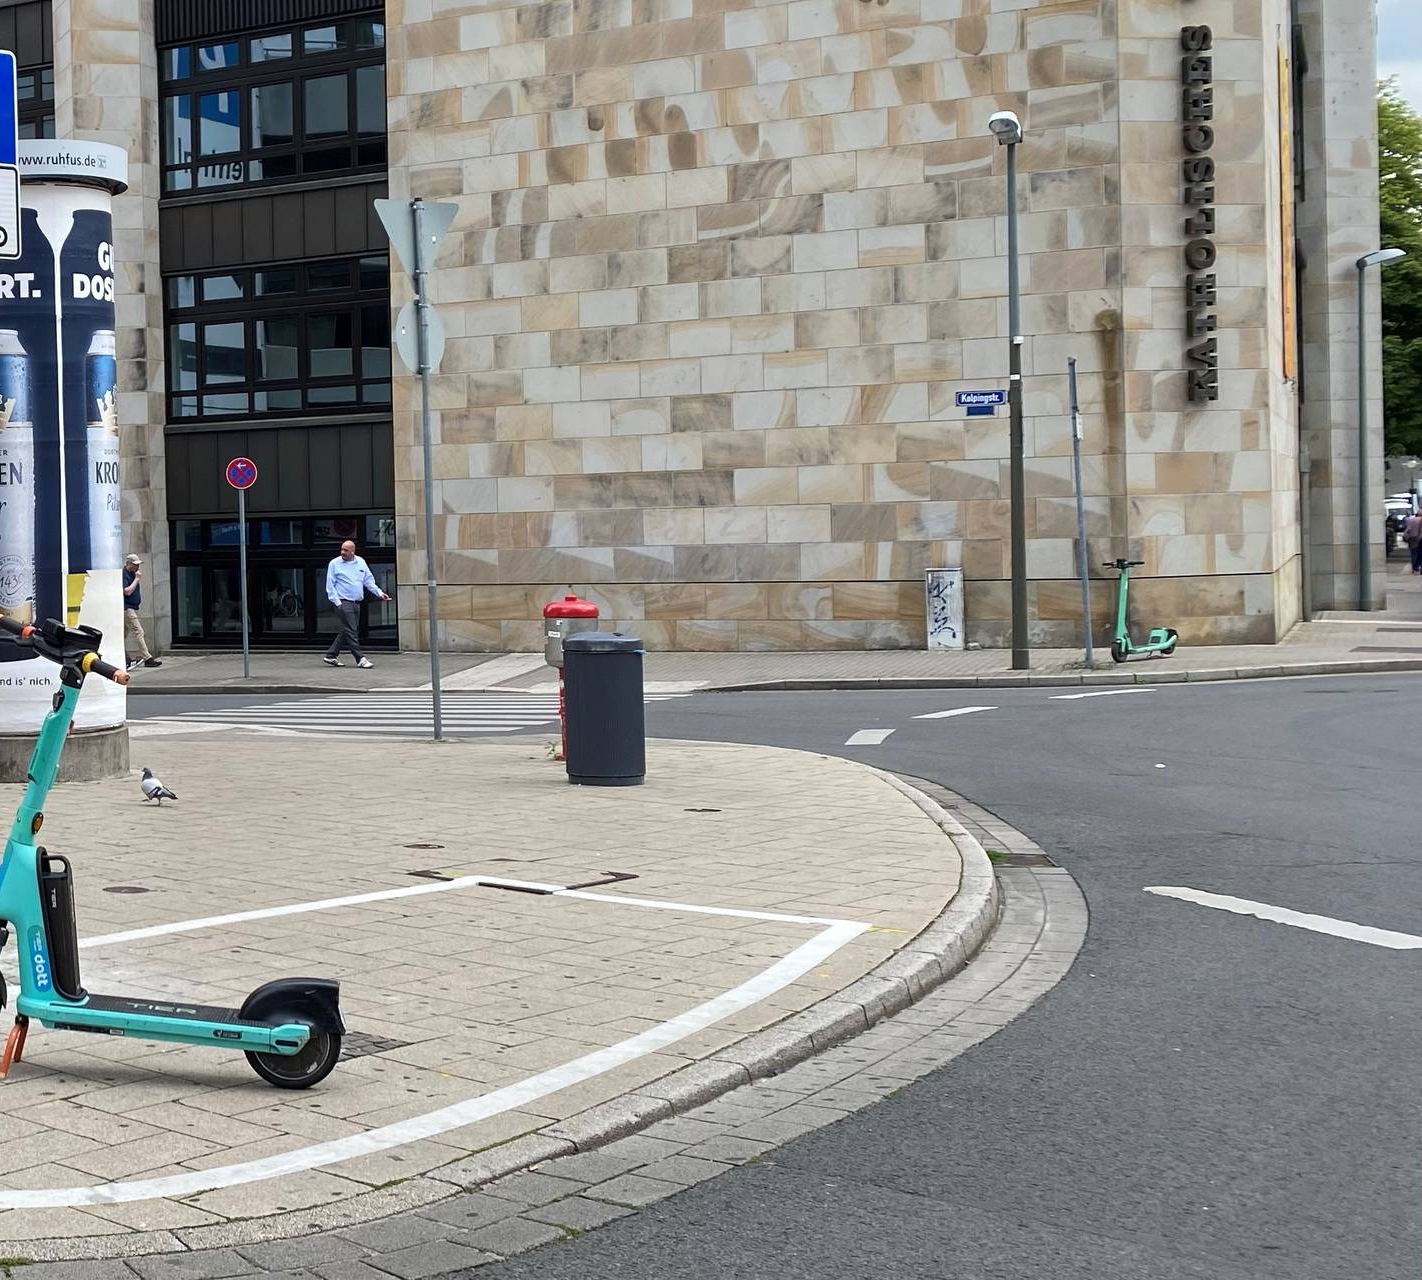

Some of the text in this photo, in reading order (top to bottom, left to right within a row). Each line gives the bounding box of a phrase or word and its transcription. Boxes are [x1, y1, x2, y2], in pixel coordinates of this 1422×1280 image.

[1181, 24, 1219, 401] KATHOLISCHES
[961, 393, 1000, 404] Kolpingstr.
[34, 954, 49, 987] dott
